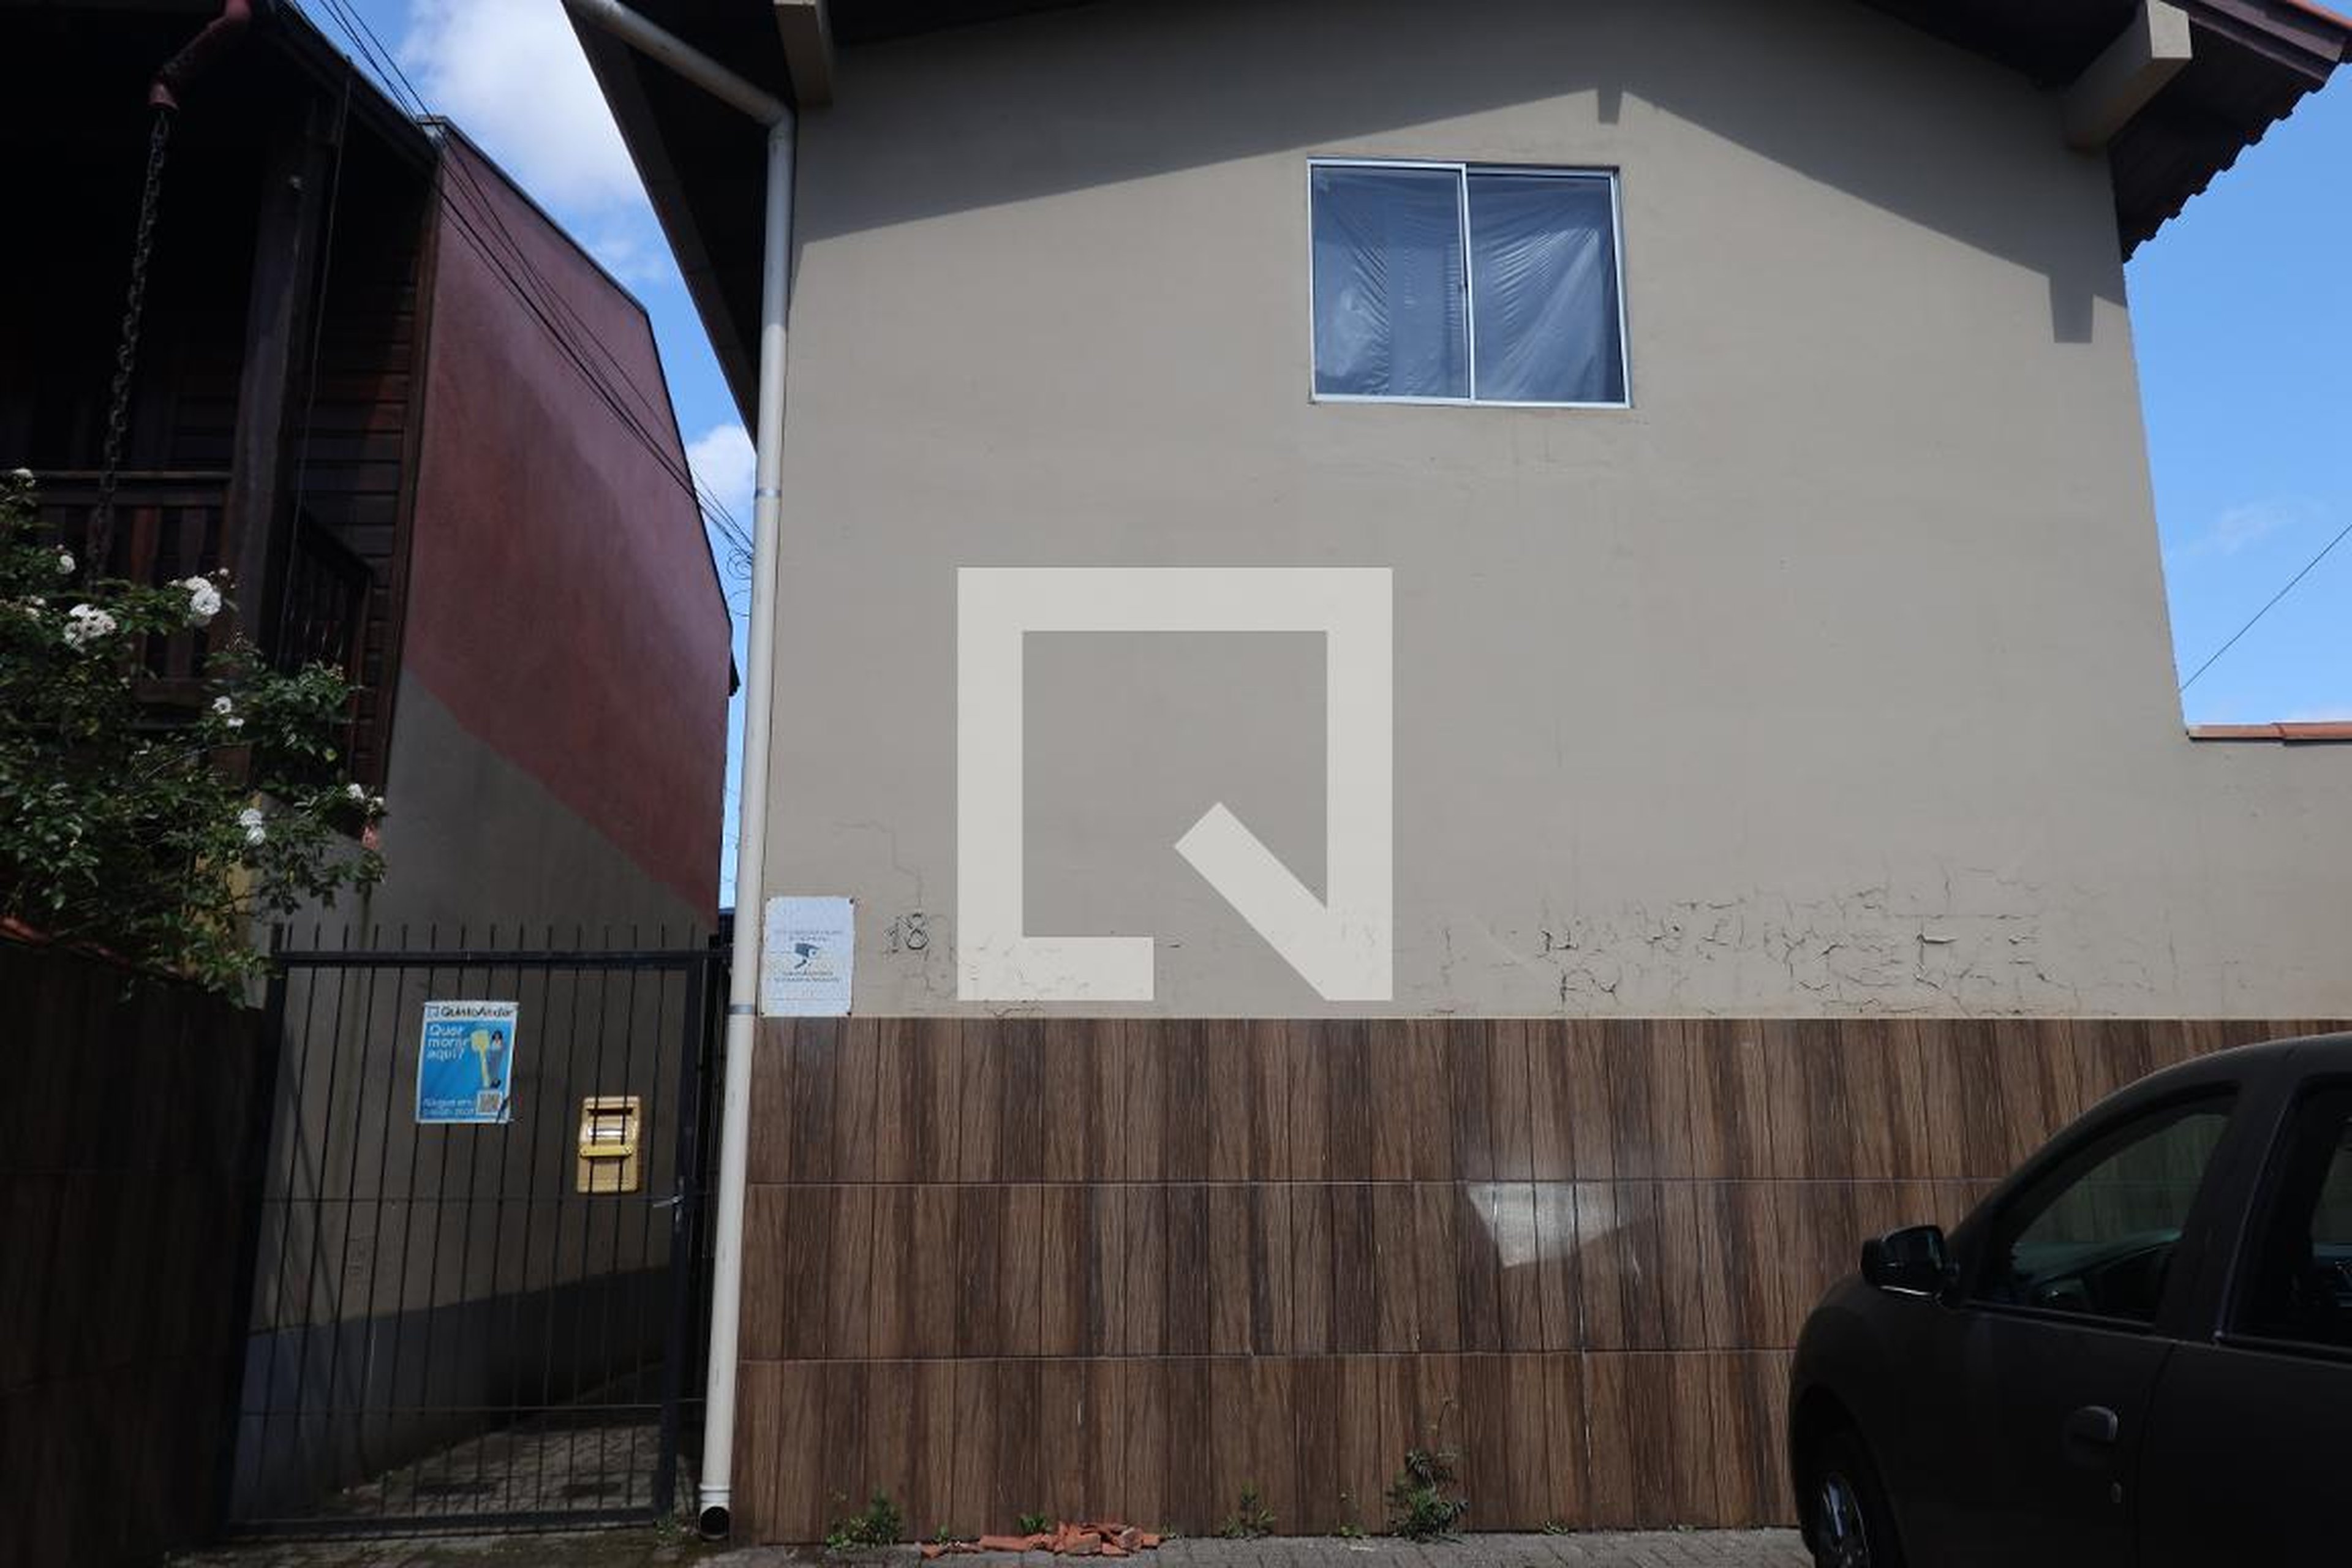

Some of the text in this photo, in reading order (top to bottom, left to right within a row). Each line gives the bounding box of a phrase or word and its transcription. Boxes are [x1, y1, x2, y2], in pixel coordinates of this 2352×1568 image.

[429, 1023, 464, 1036] Quer
[428, 1038, 469, 1047] morar
[426, 1047, 464, 1061] aqui?
